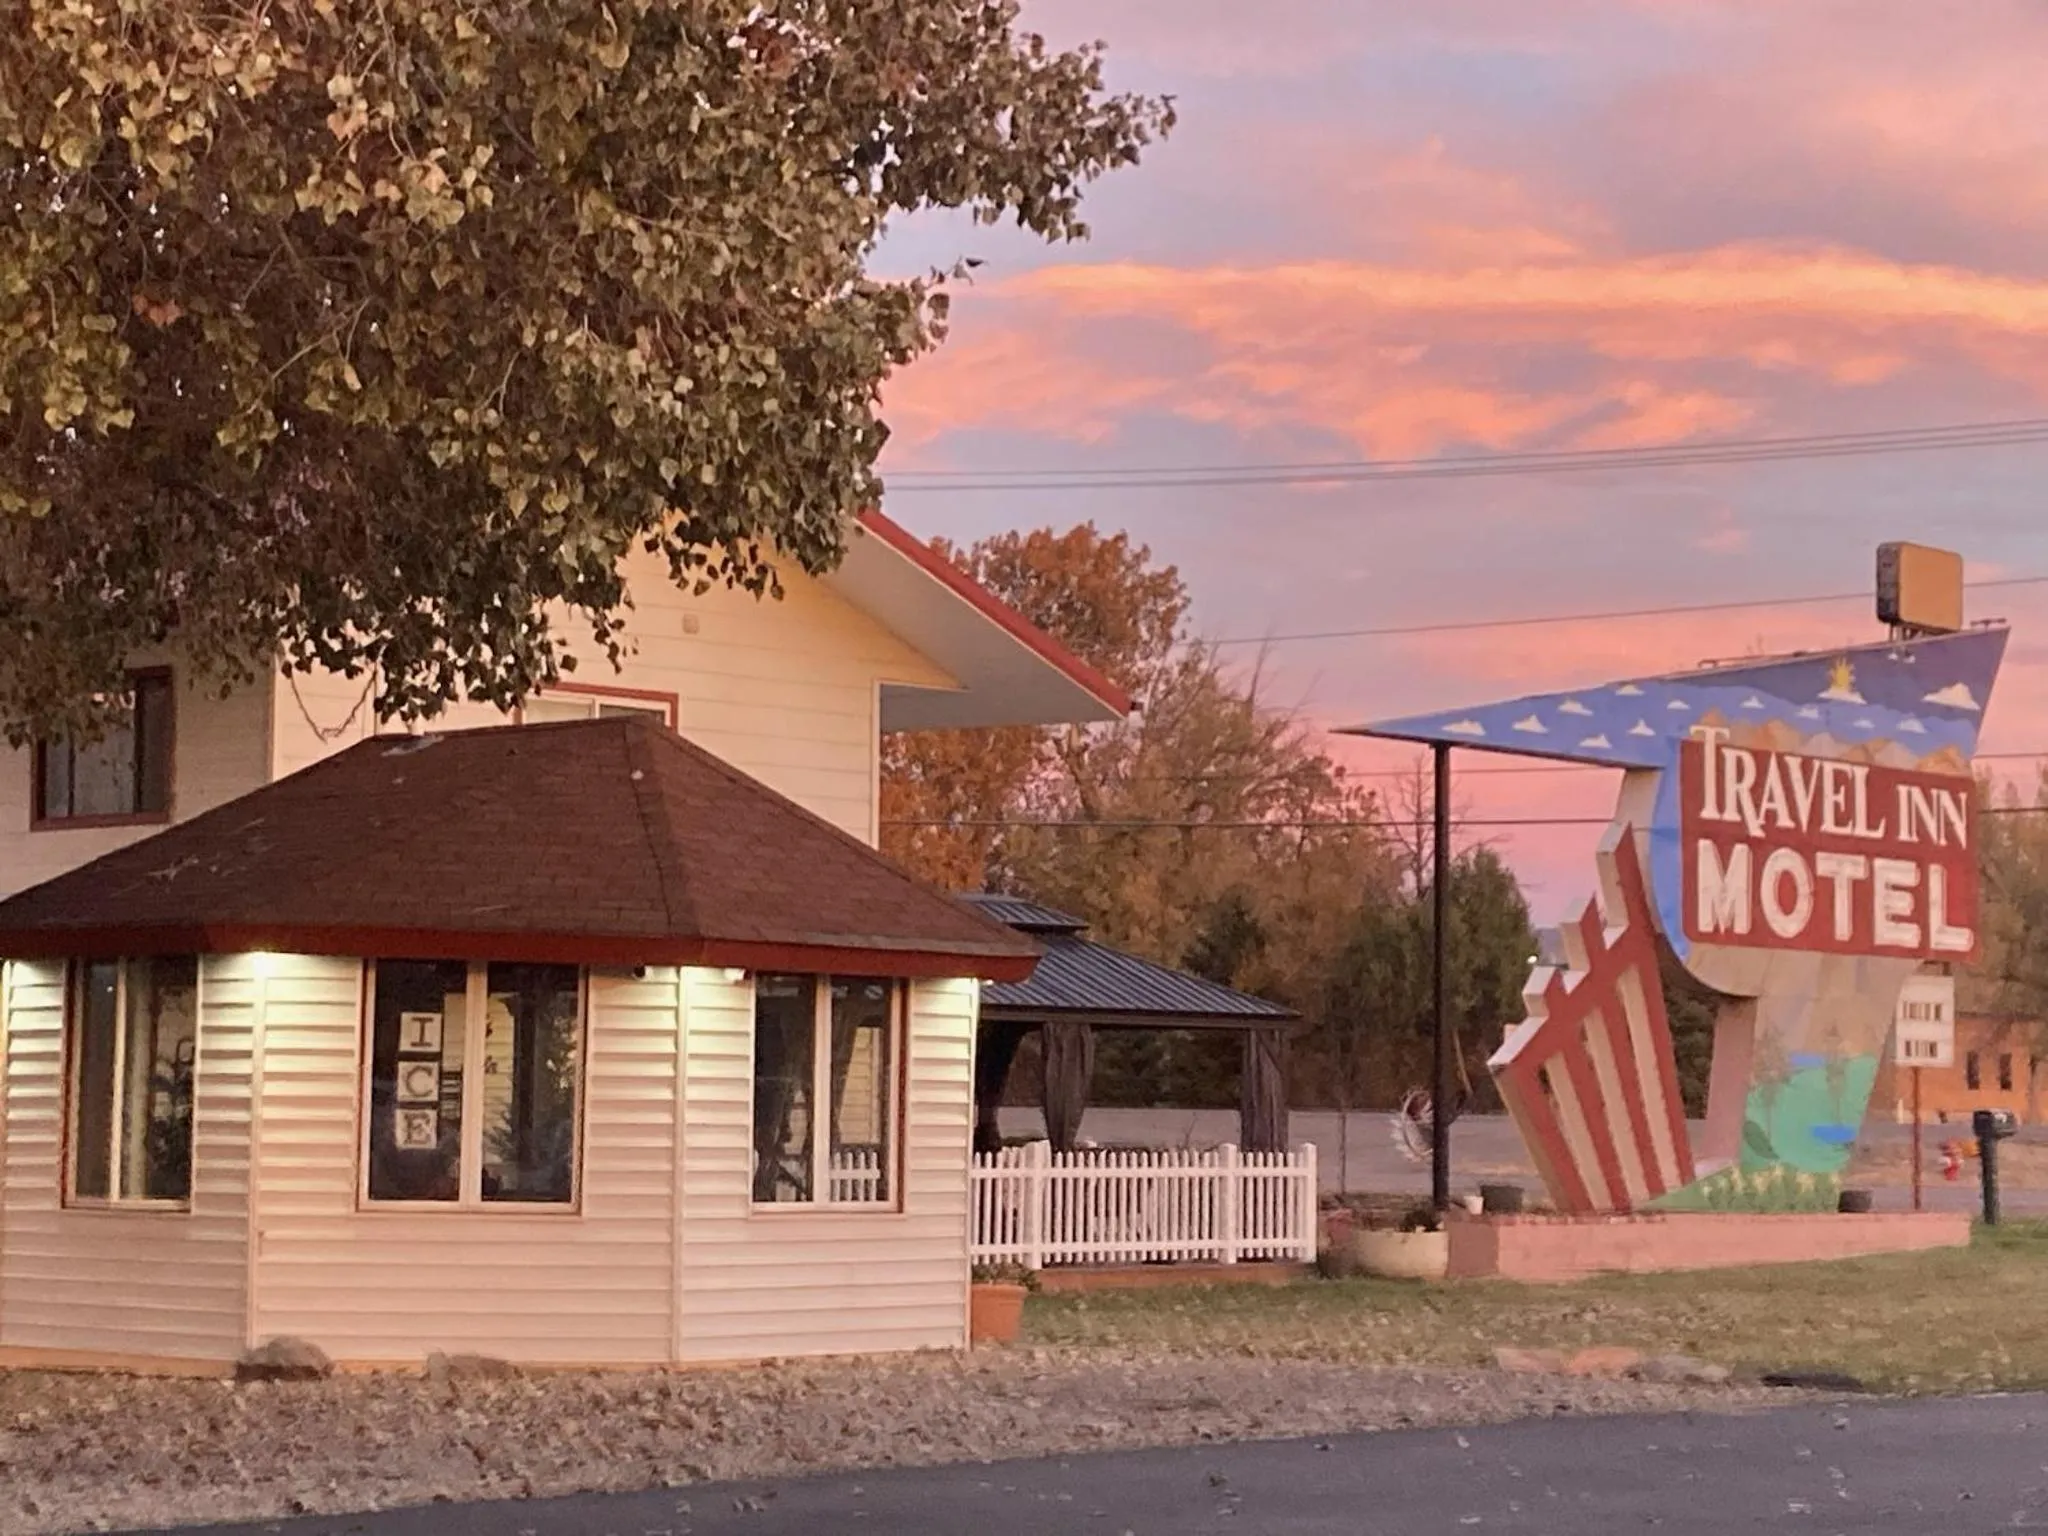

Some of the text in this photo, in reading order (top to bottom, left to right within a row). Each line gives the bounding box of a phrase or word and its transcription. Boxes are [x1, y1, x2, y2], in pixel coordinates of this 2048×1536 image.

[1690, 725, 1968, 849] TRAVEL INN
[1697, 839, 1974, 951] MOTEL
